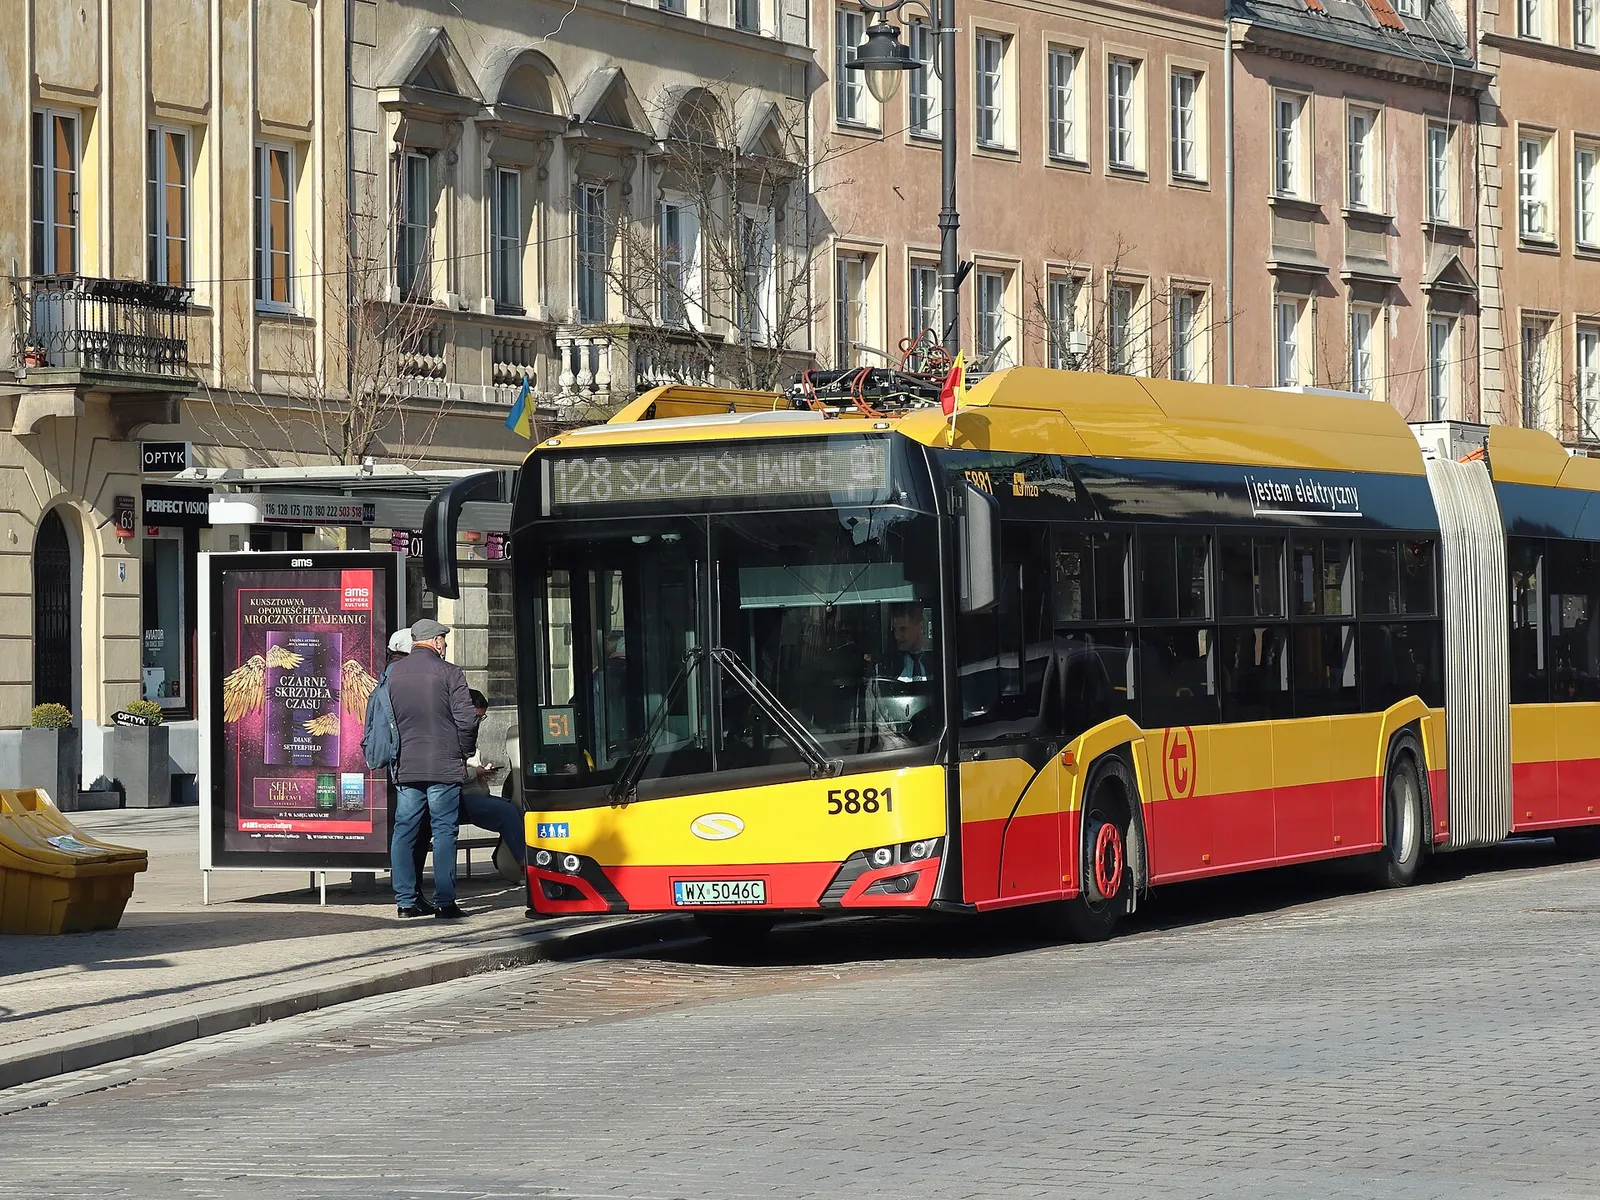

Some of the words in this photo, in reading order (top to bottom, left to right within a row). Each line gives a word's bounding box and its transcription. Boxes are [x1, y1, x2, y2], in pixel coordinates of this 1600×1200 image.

[144, 451, 185, 464] OPTYK
[554, 457, 612, 503] 128
[1250, 475, 1293, 507] jestem
[1295, 477, 1359, 511] elektryczny
[146, 499, 183, 514] PERFECT
[265, 503, 276, 515] 116
[277, 504, 288, 516] 128
[290, 504, 301, 516] 175
[302, 505, 313, 517] 178
[315, 505, 325, 517] 180
[326, 506, 338, 518] 222
[339, 506, 350, 518] 503
[352, 506, 362, 518] 518
[121, 510, 133, 529] 63
[291, 558, 313, 567] ams
[344, 588, 369, 597] ams
[250, 598, 305, 606] KUNSZTOWNA
[258, 606, 301, 614] OPOWIEŚĆ
[244, 614, 309, 624] MROCZNYCH
[312, 615, 366, 624] TAJEMNIC
[279, 676, 327, 687] CZARNE
[274, 685, 331, 699] SKRZYDŁA
[285, 698, 321, 709] CZASU
[117, 713, 146, 726] OPTYK
[548, 715, 569, 737] 51
[283, 743, 322, 751] SETTERFIELD
[827, 788, 893, 815] 5881
[685, 883, 706, 900] WX
[712, 883, 760, 899] 5046C
